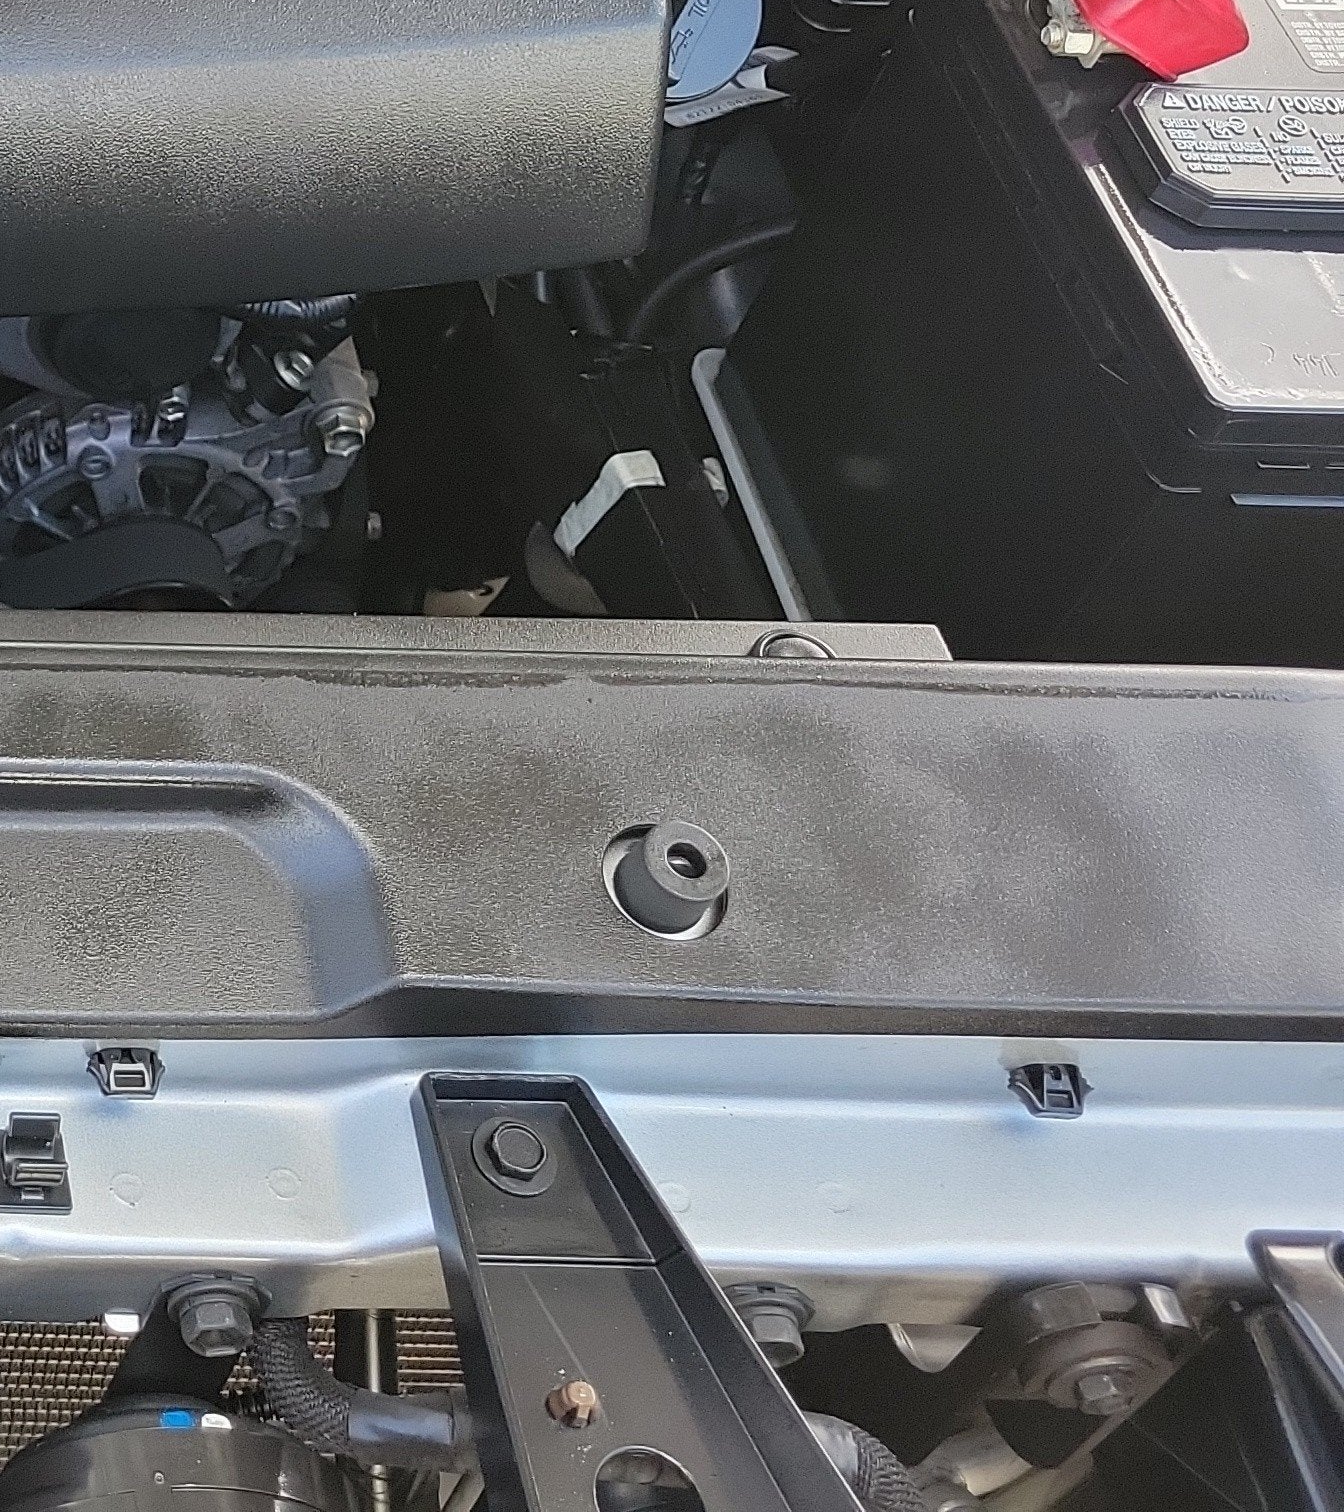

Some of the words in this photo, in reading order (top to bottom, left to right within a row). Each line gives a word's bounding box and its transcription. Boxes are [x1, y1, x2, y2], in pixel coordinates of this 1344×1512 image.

[1185, 92, 1264, 112] DANGER
[1162, 117, 1200, 130] SHIELD
[1166, 129, 1196, 141] EYES
